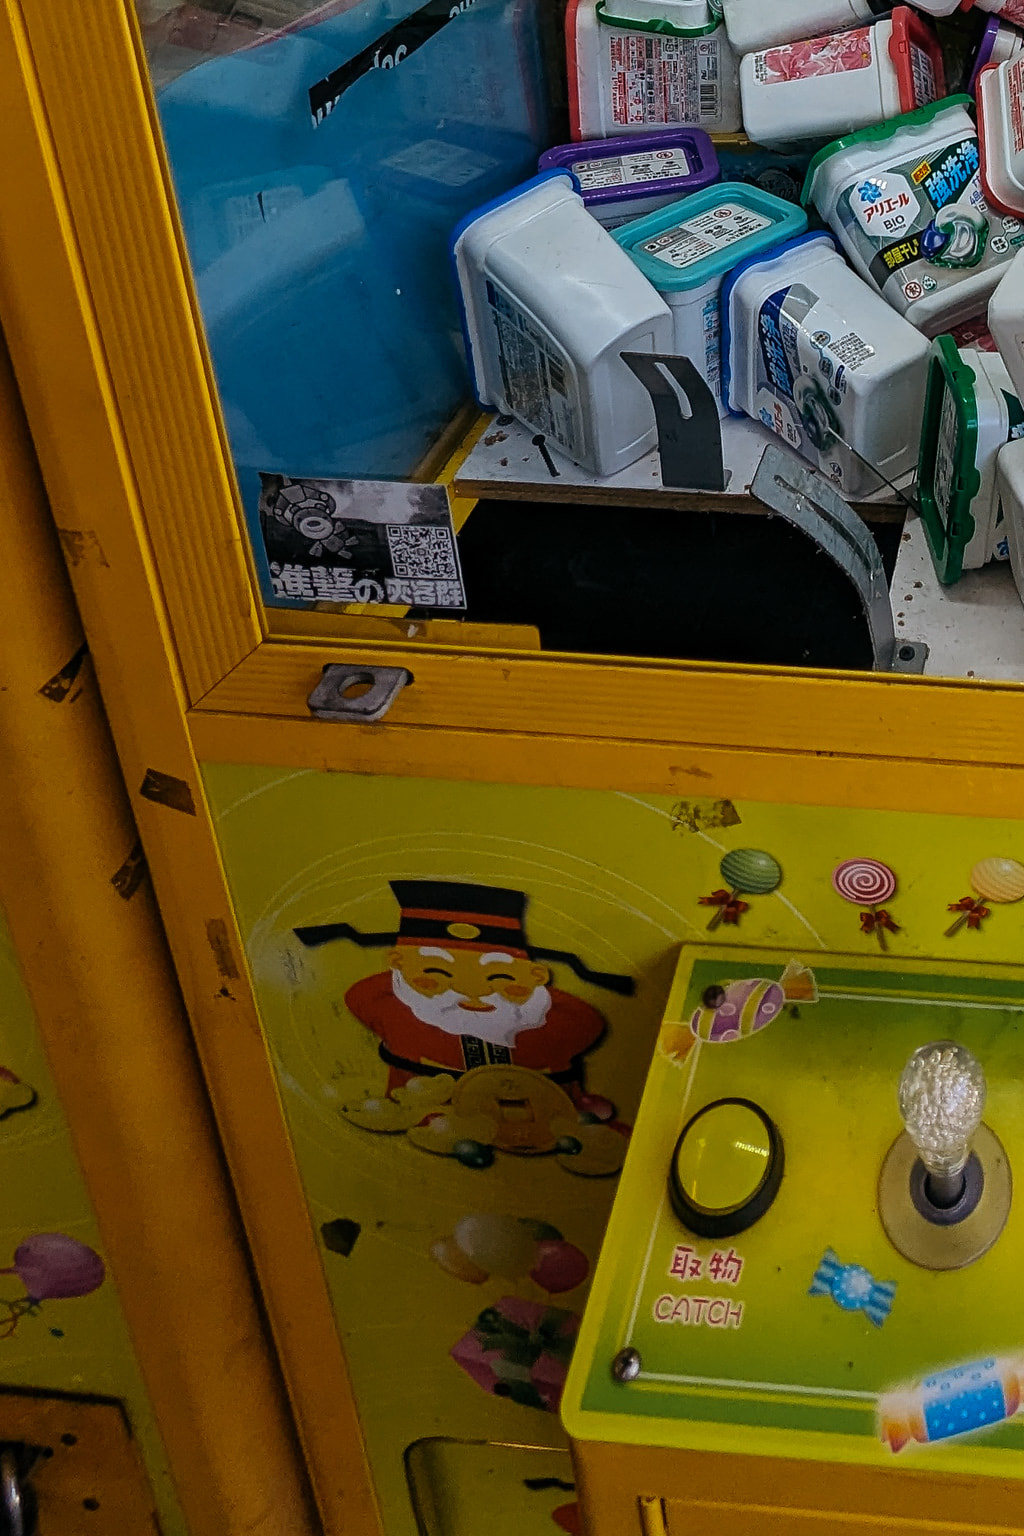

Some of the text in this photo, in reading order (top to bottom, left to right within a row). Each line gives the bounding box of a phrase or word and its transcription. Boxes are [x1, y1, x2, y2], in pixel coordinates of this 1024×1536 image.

[925, 140, 979, 208] 強洗浄
[863, 192, 910, 224] アリエール
[883, 214, 906, 231] BIO
[670, 1245, 743, 1283] 取物
[654, 1295, 743, 1327] CATCH
